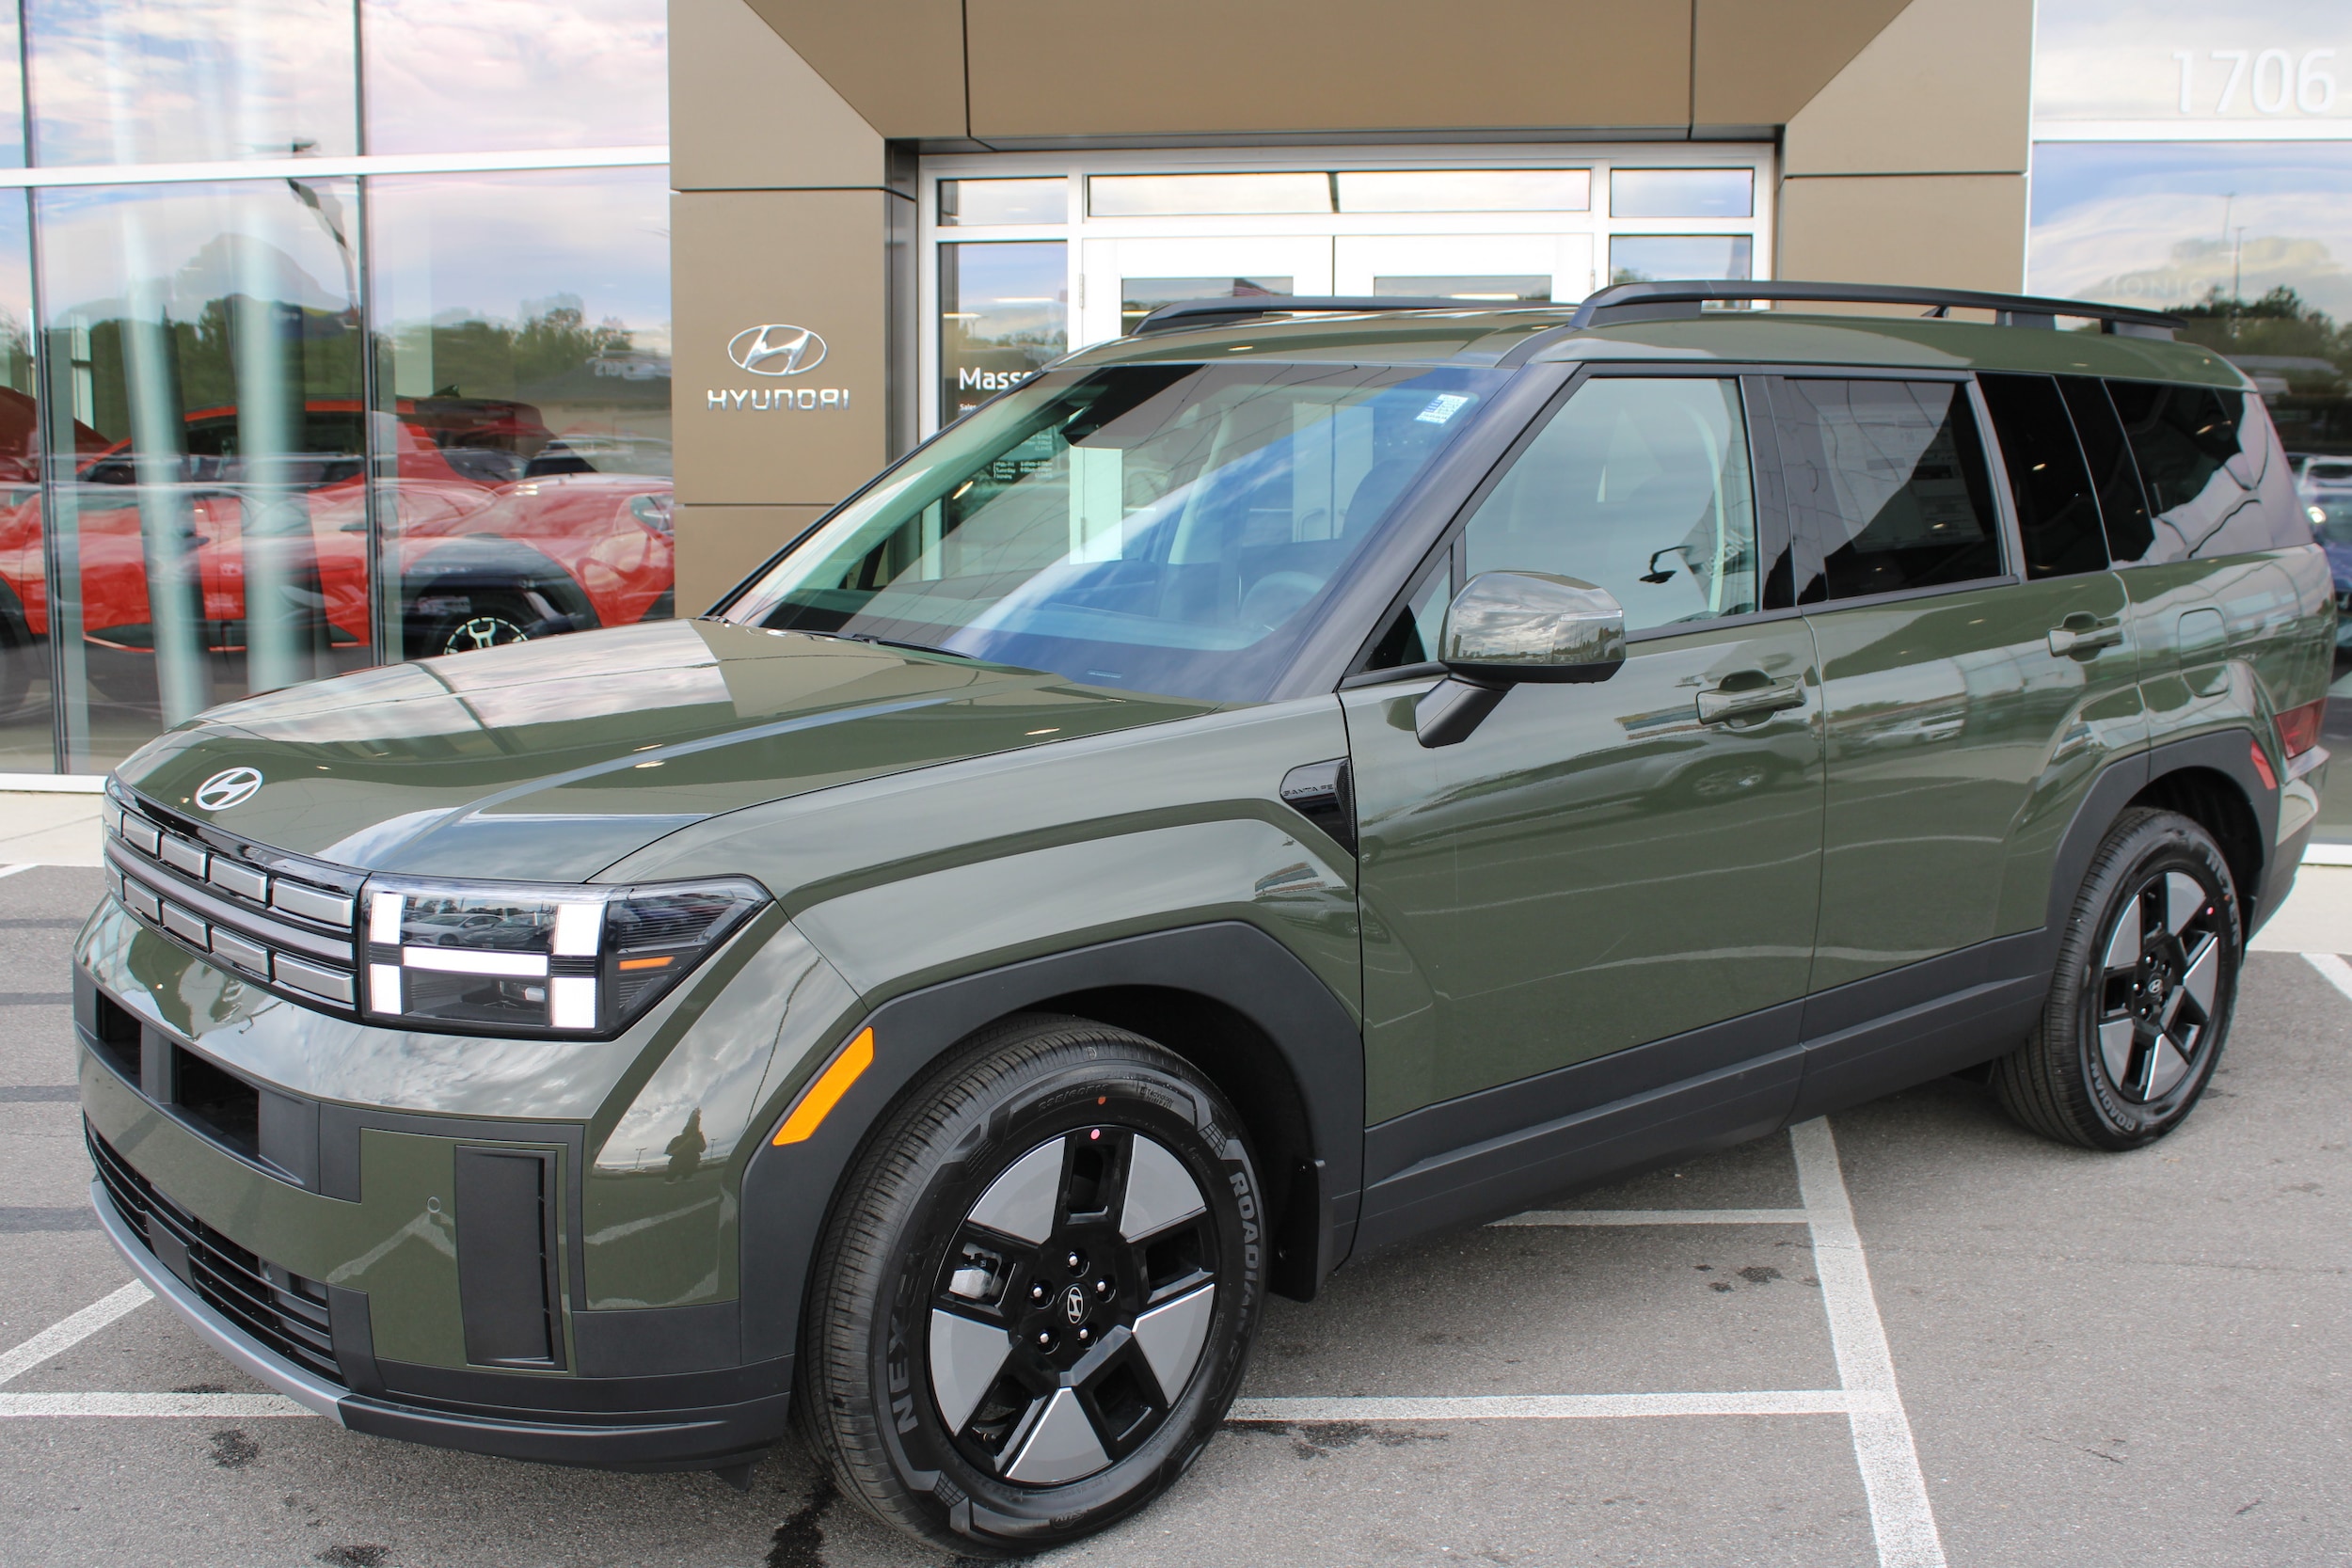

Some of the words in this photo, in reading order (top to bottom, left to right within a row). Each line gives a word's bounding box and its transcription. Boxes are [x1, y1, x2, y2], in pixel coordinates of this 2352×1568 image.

[2171, 48, 2336, 114] 1706
[707, 388, 850, 411] HYUNDAI
[1282, 785, 1319, 797] SANTA
